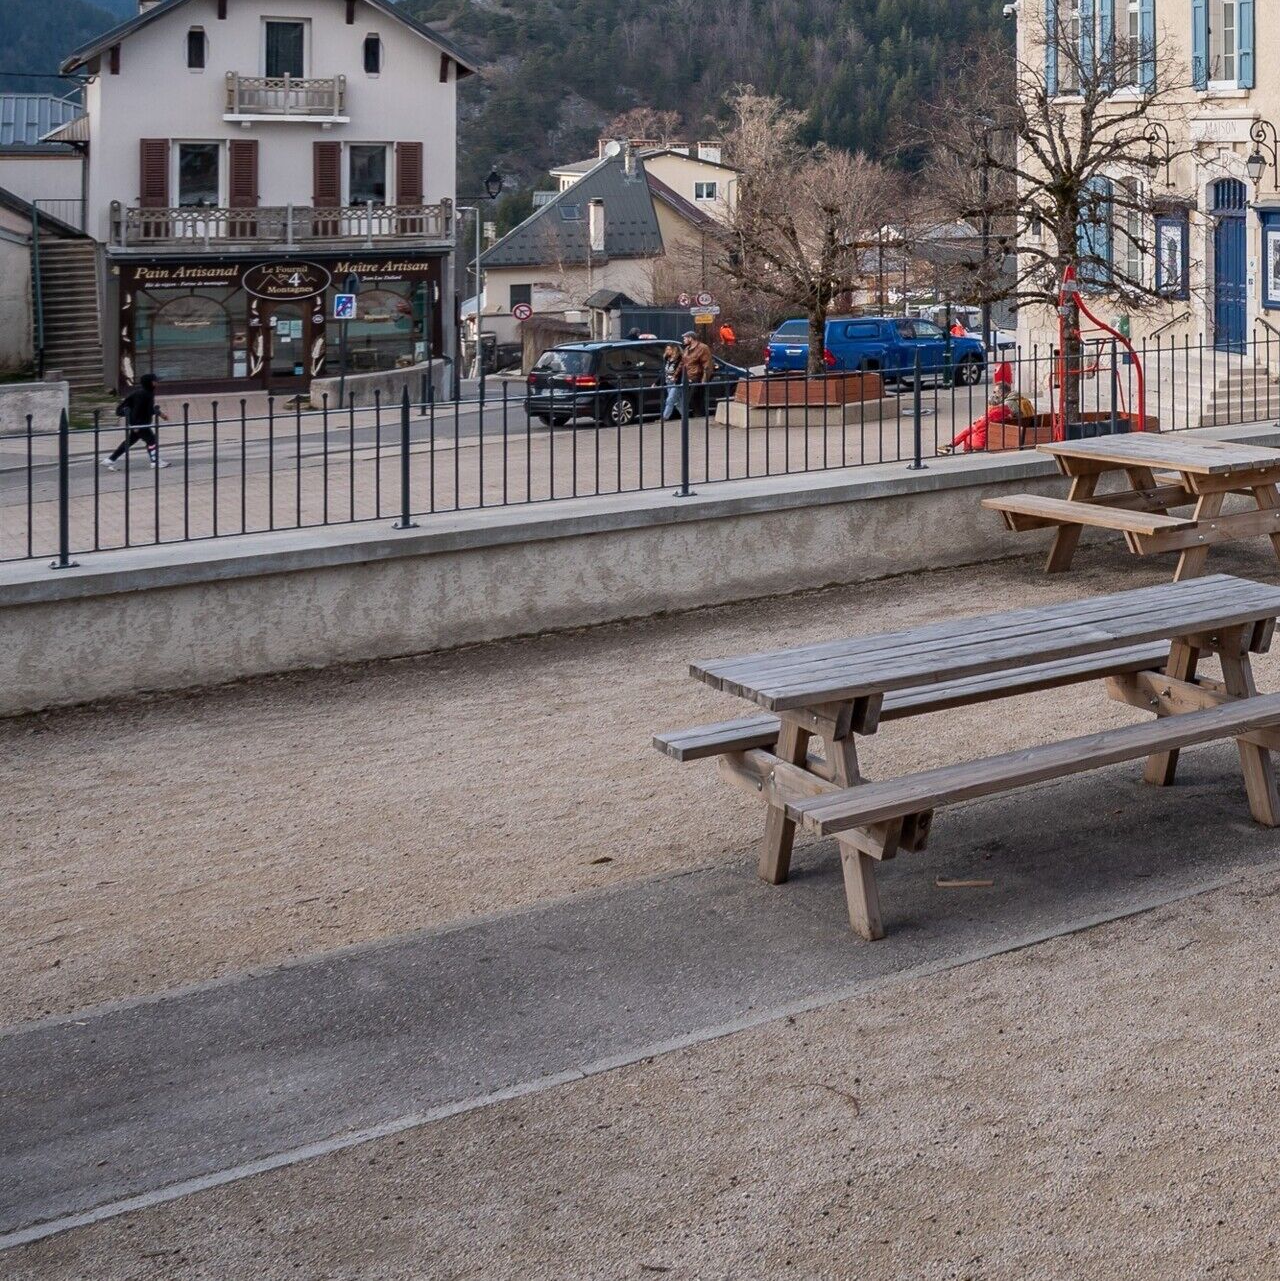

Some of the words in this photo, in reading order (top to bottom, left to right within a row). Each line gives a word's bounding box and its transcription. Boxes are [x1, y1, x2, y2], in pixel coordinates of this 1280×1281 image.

[134, 267, 169, 279] Pain
[172, 265, 239, 278] Artisanal
[334, 261, 377, 273] Maître
[380, 261, 428, 272] Artisan
[289, 272, 301, 287] 4
[268, 286, 313, 294] Montagnes
